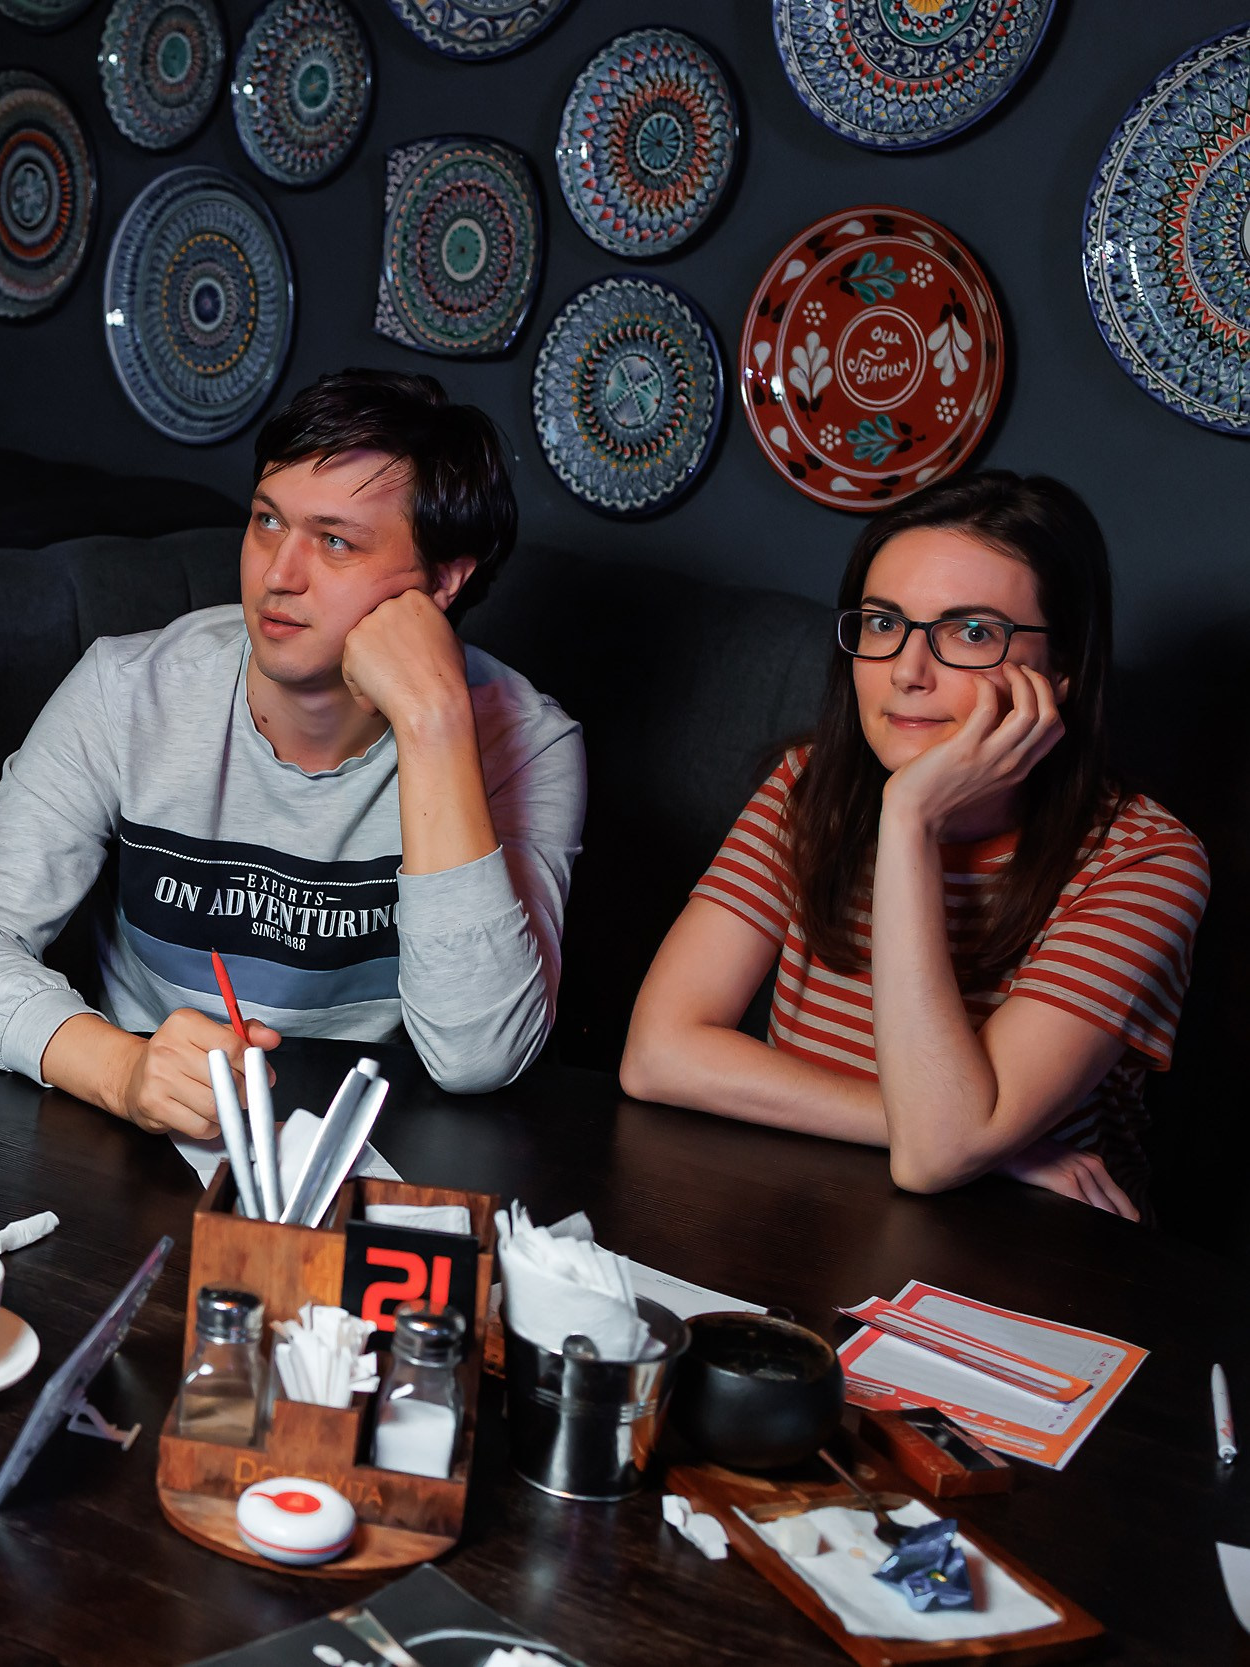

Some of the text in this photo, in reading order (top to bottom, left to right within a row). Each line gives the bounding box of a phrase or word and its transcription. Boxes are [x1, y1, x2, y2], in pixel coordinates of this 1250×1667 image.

[154, 876, 203, 912] ON
[247, 873, 324, 906] EXPERTS
[361, 1246, 452, 1333] 21
